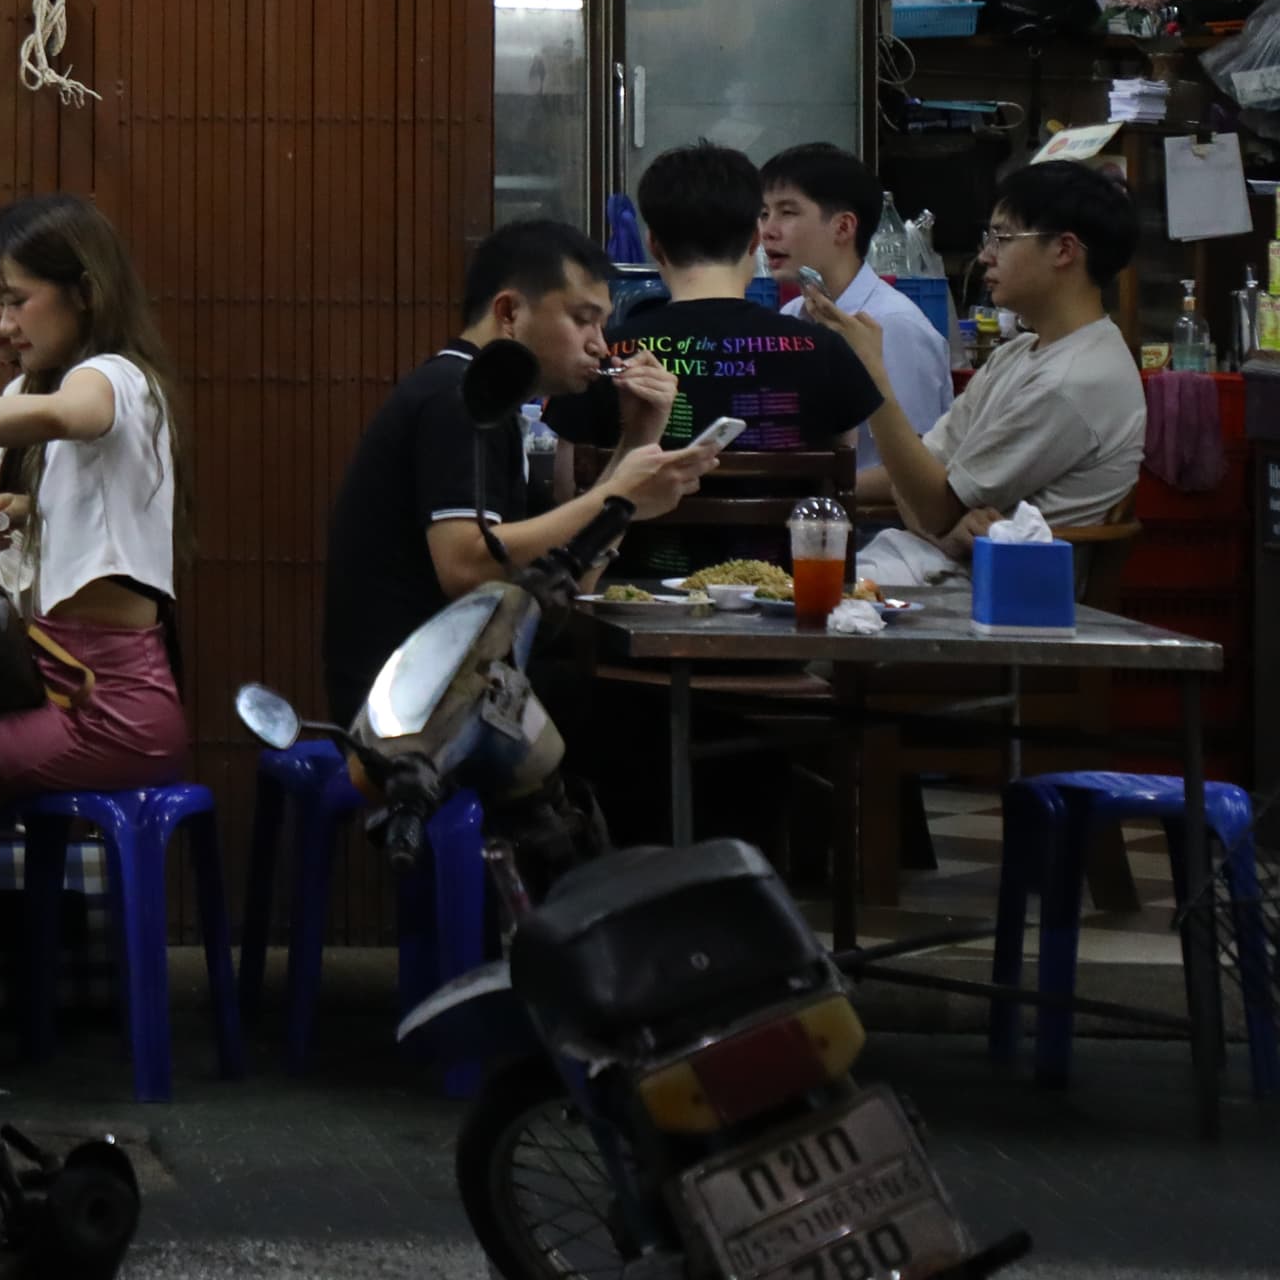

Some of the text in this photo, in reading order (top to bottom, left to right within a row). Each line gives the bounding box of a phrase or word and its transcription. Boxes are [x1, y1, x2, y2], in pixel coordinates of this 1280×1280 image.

[676, 335, 694, 355] of
[695, 335, 718, 352] the
[721, 336, 816, 353] SPHERES
[665, 360, 757, 377] LIVE 2024
